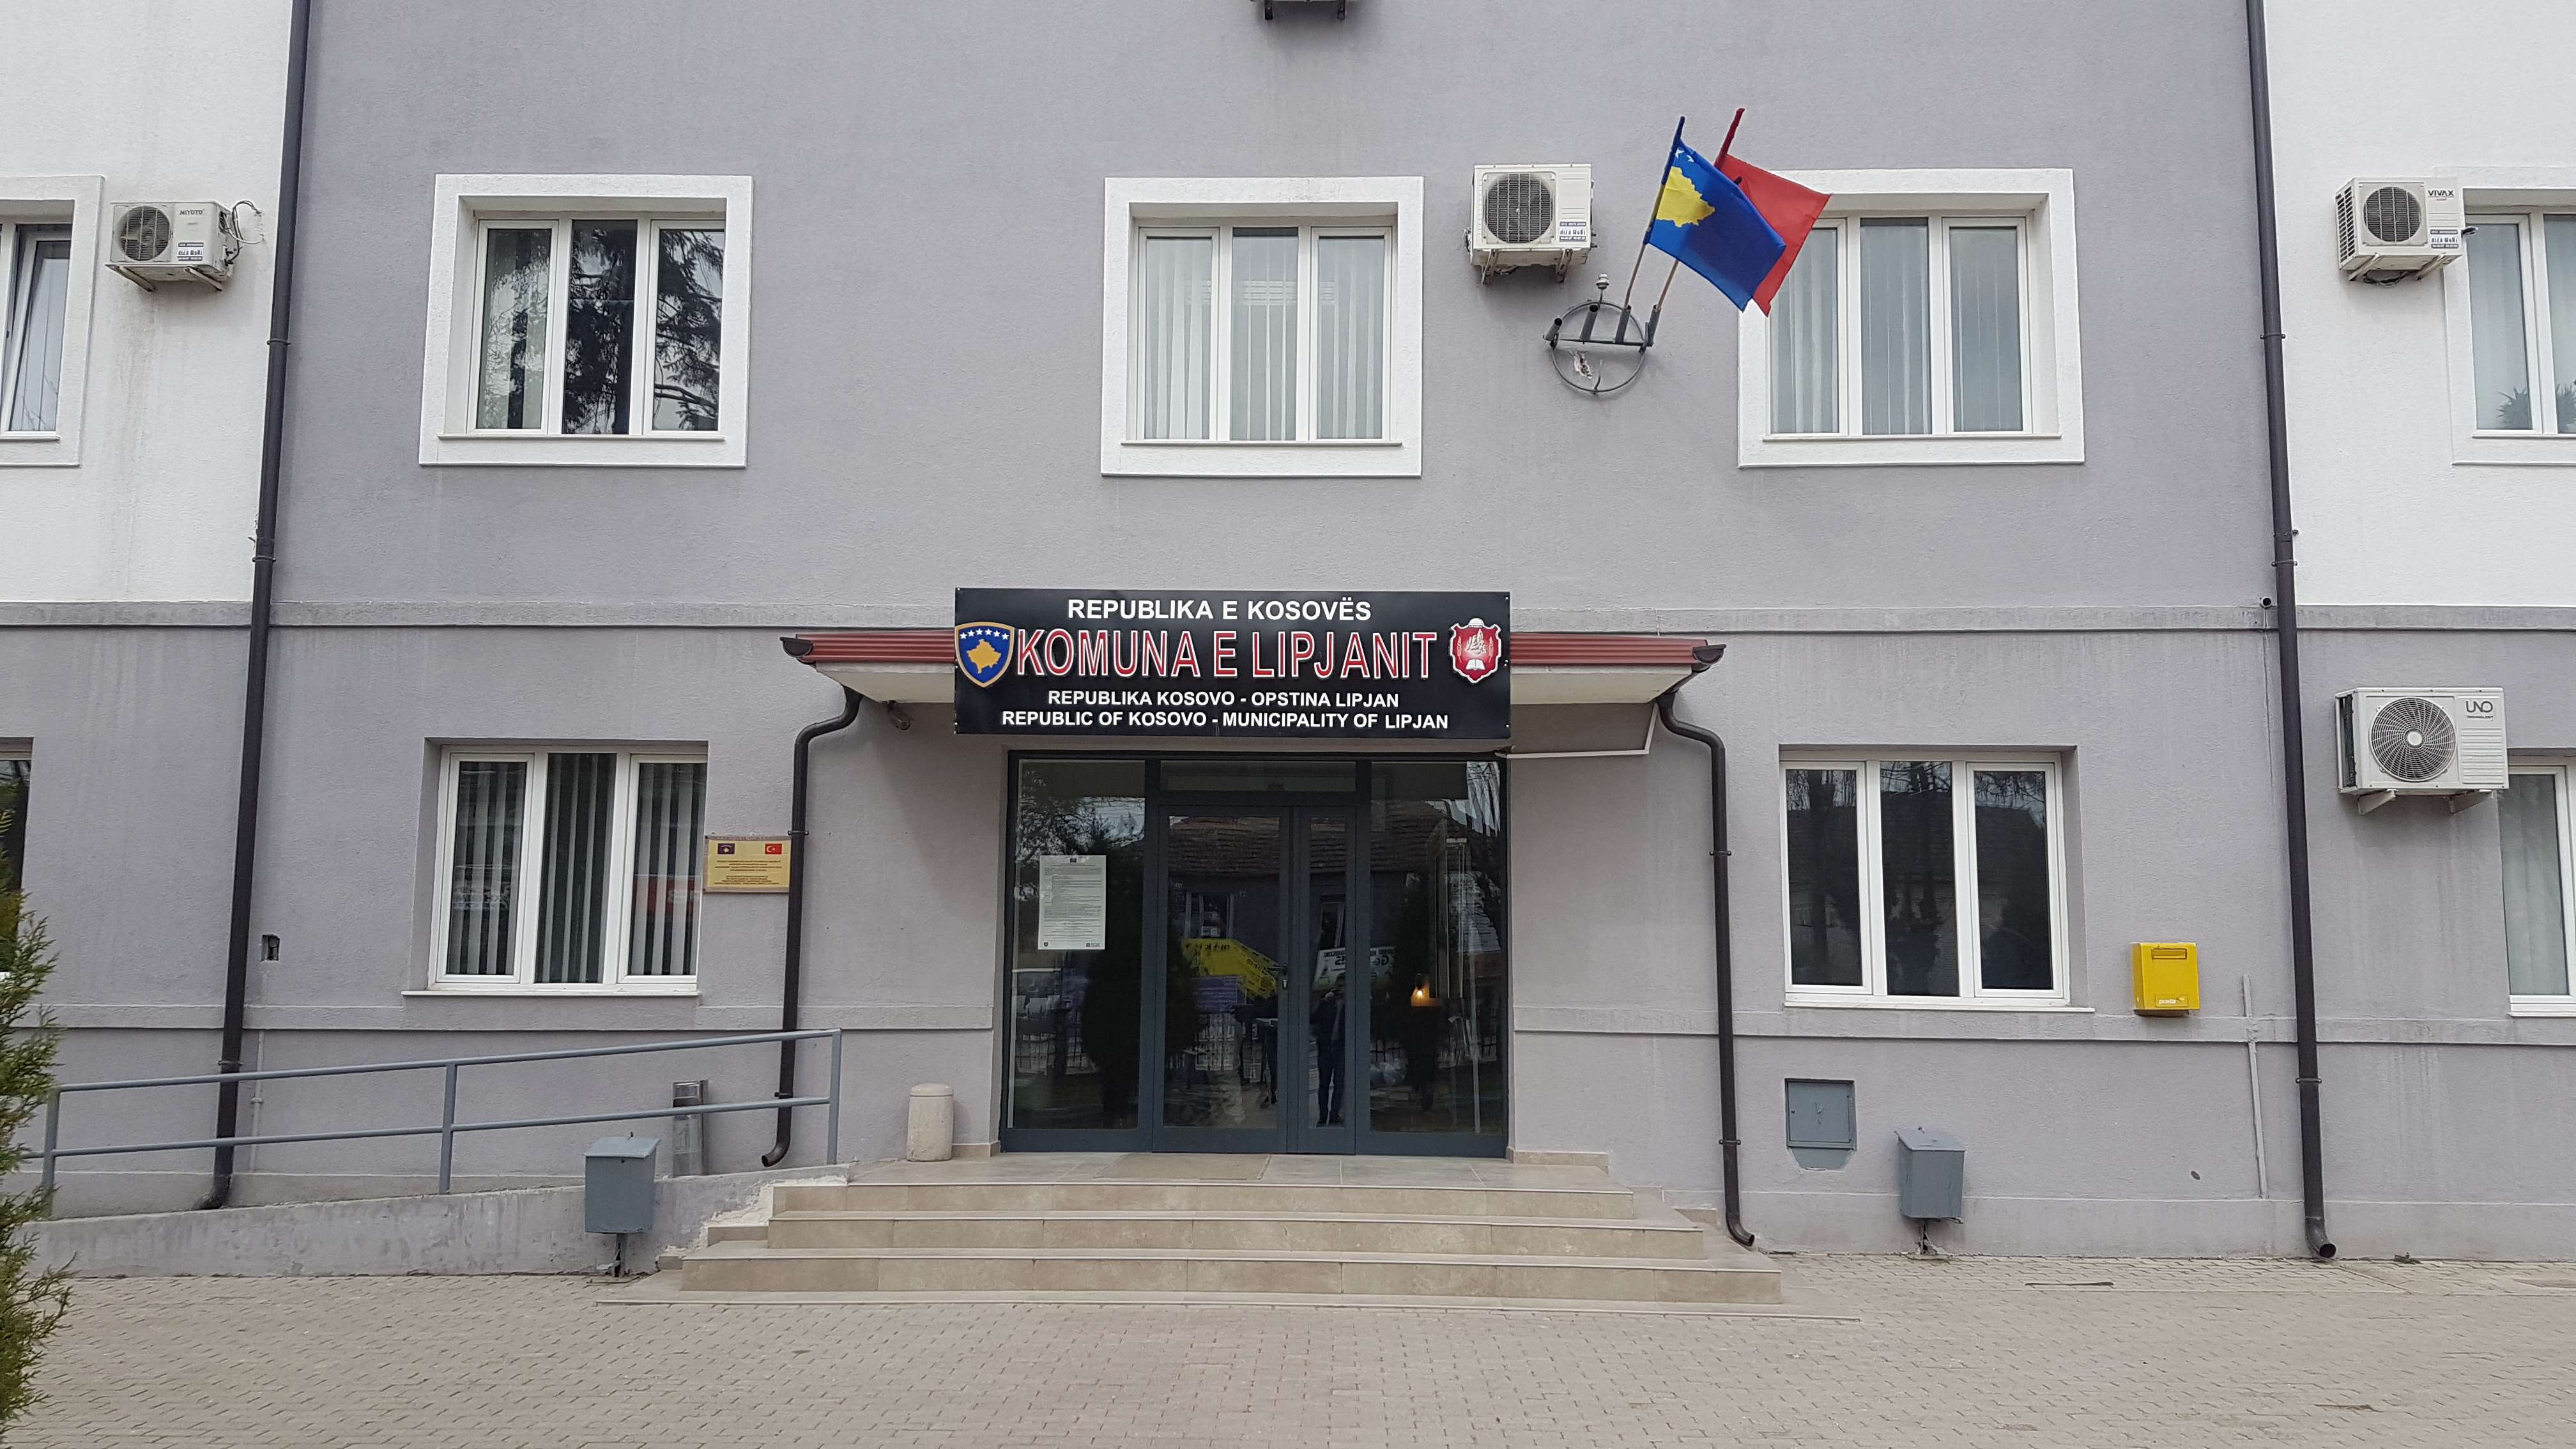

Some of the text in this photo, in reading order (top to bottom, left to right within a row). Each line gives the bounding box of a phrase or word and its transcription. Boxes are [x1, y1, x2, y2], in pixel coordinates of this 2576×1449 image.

[1068, 597, 1371, 621] REPUBLIKA E KOSOVËS
[1017, 628, 1438, 679] KOMUNA E LIPJANIT
[1048, 690, 1153, 705] REPUBLIKA
[1157, 691, 1235, 706] KOSOVO
[1251, 692, 1331, 707] OPSTINA
[1336, 693, 1399, 707] LIPJAN
[2465, 700, 2494, 713] UNO
[1002, 710, 1093, 726] REPUBLIC
[1098, 711, 1123, 726] OF
[1129, 711, 1207, 726] KOSOVO
[1223, 712, 1349, 728] MUNICIPALITY
[1353, 713, 1378, 728] OF
[1385, 714, 1448, 729] LIPJAN
